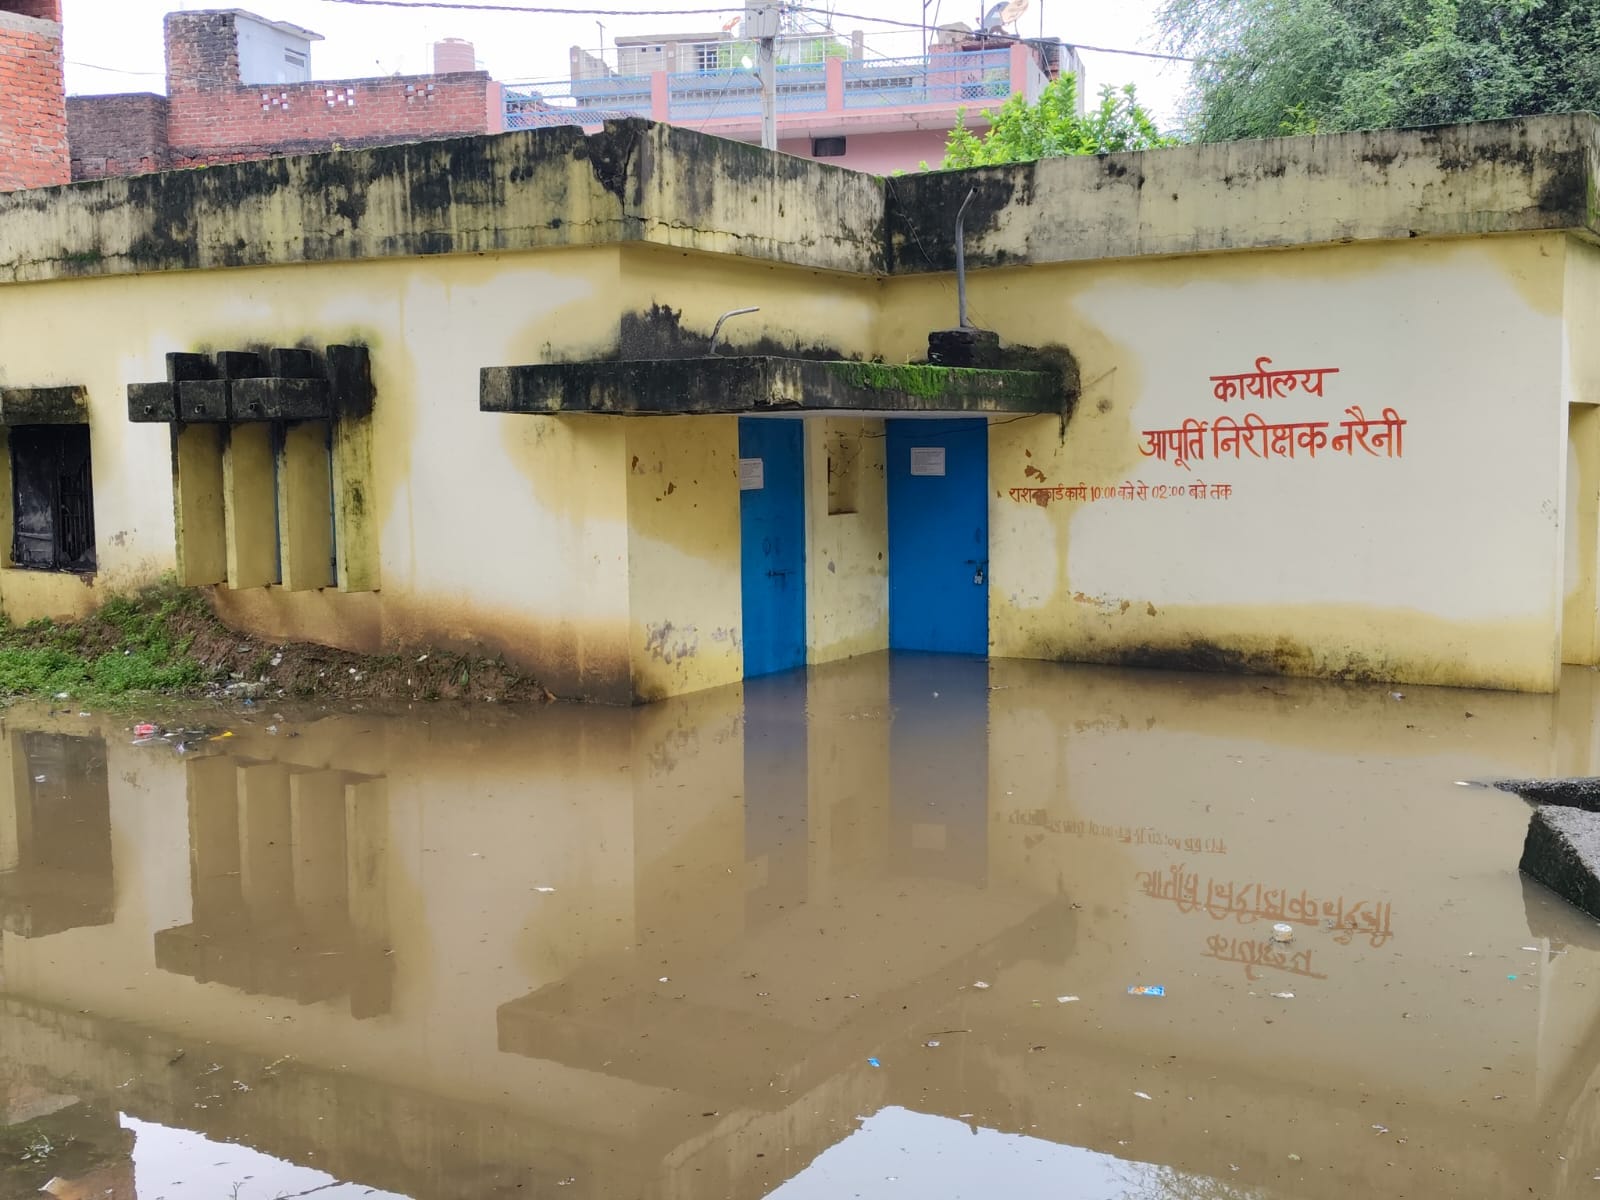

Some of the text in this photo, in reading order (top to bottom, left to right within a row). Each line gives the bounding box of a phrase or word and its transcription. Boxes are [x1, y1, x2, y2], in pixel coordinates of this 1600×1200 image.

[1209, 356, 1340, 403] कार्यालय
[1137, 405, 1408, 472] आपूर्ति निरीक्षक नरैनी
[1090, 485, 1116, 502] 10:00
[1117, 480, 1135, 501] बजे
[1136, 479, 1150, 502] से
[1151, 484, 1185, 500] 02:00
[1188, 478, 1208, 500] बजे
[1209, 484, 1233, 500] तक
